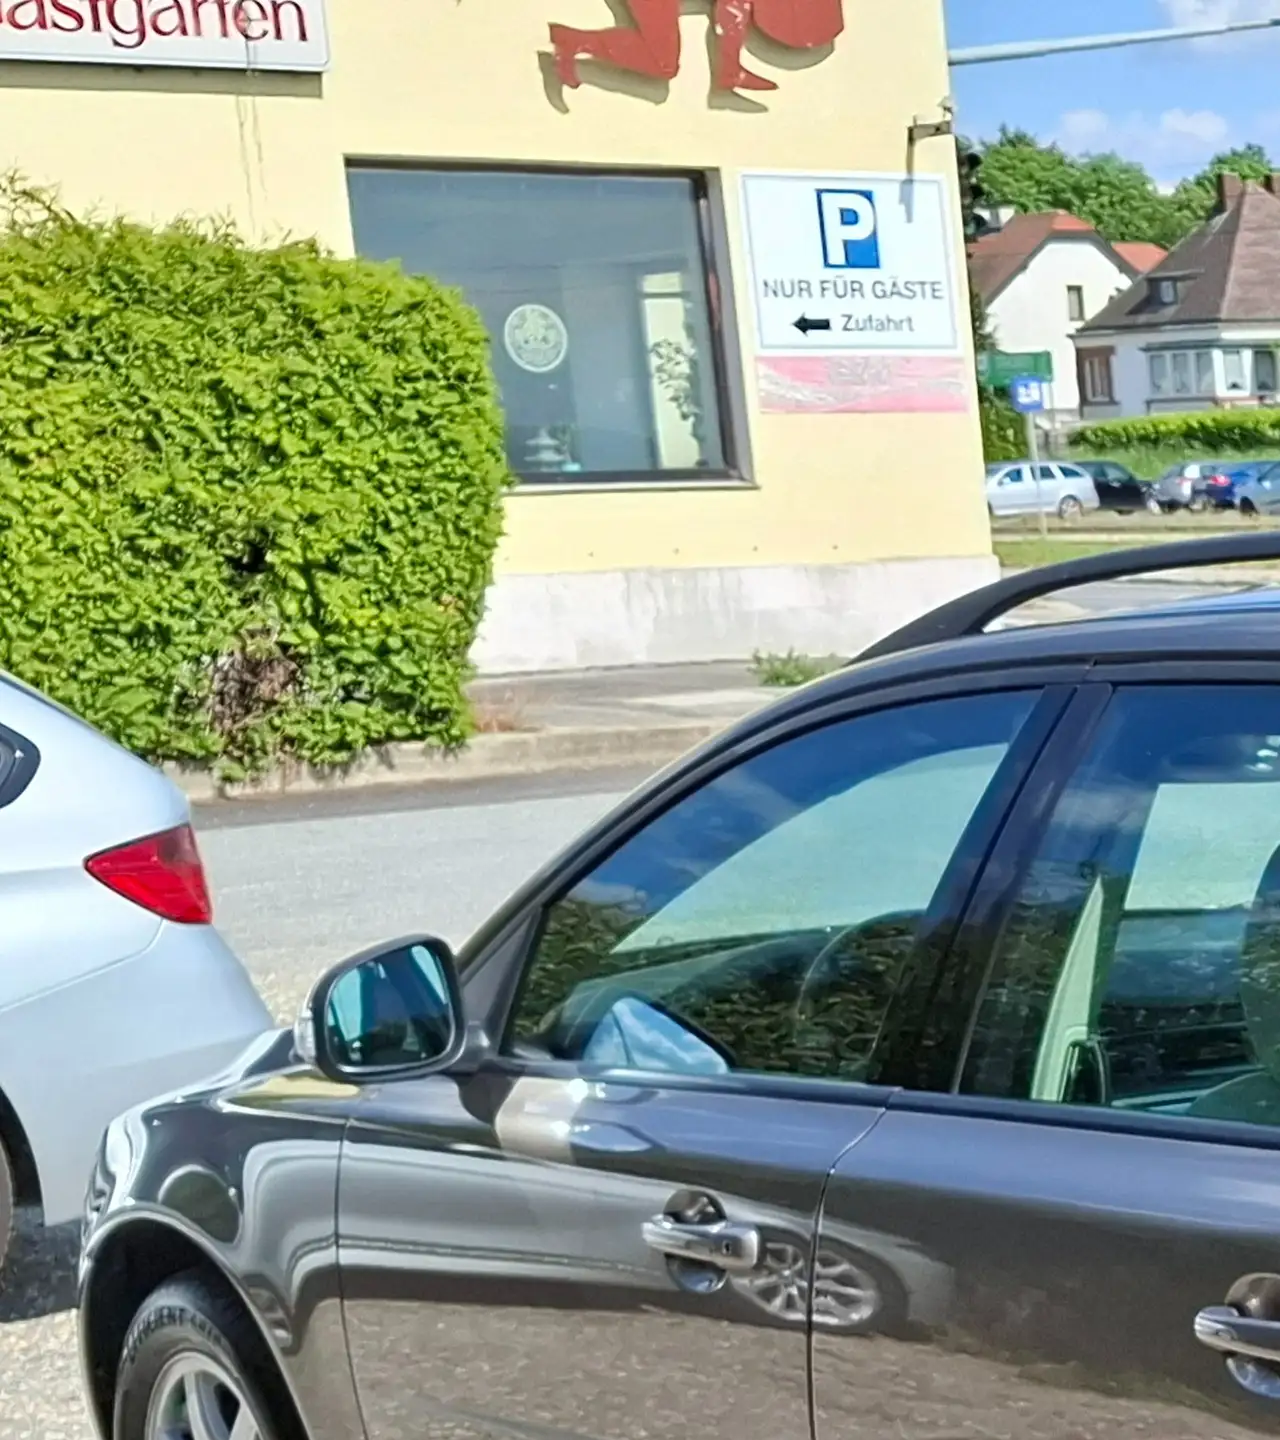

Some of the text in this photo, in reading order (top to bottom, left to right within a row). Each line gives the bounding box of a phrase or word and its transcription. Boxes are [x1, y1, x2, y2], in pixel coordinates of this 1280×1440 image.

[0, 0, 308, 48] astgarten
[820, 192, 876, 267] P
[763, 275, 944, 300] NUR FÜR GÄSTE
[841, 314, 914, 332] Zufahrt
